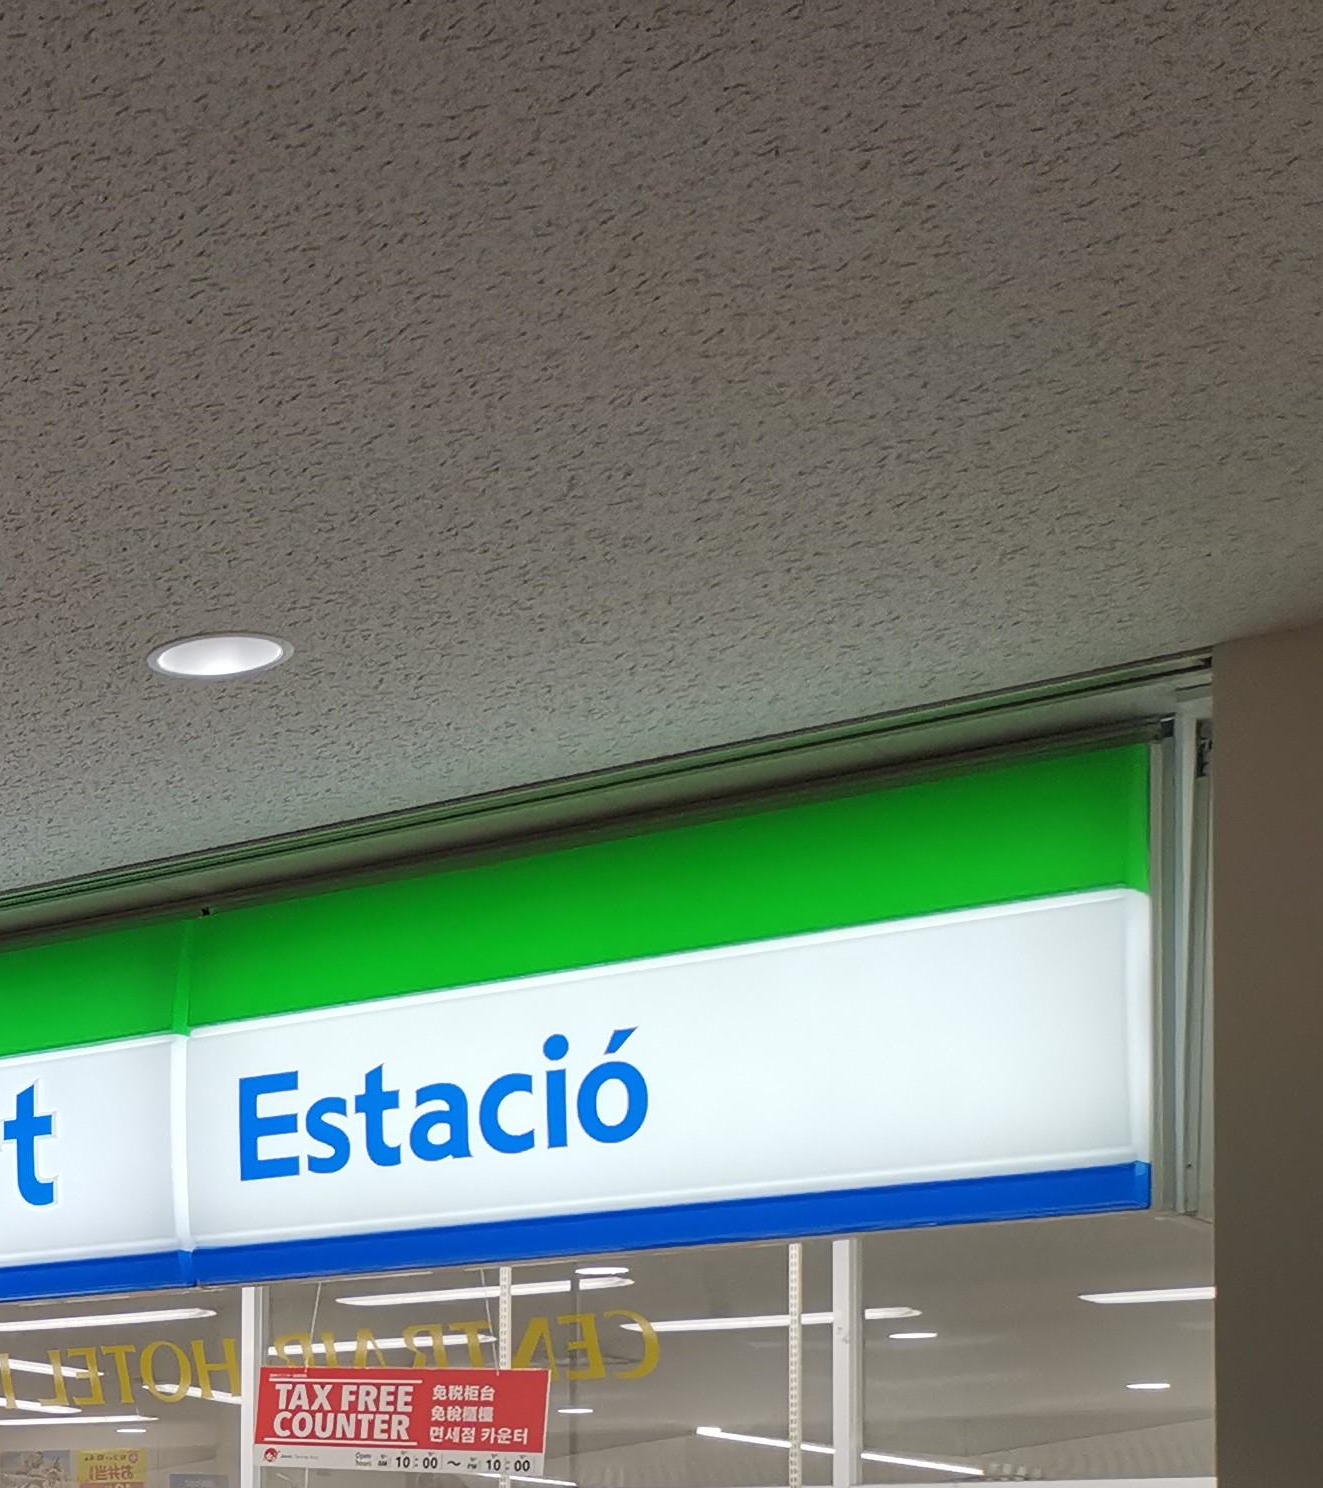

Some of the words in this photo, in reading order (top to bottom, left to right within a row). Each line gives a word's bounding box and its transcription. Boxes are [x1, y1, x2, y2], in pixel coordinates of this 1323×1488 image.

[235, 1026, 651, 1184] Estació
[275, 1384, 334, 1411] TAX
[341, 1385, 413, 1413] FREE
[432, 1385, 496, 1402] 免税柜台
[273, 1412, 410, 1440] COUNTER
